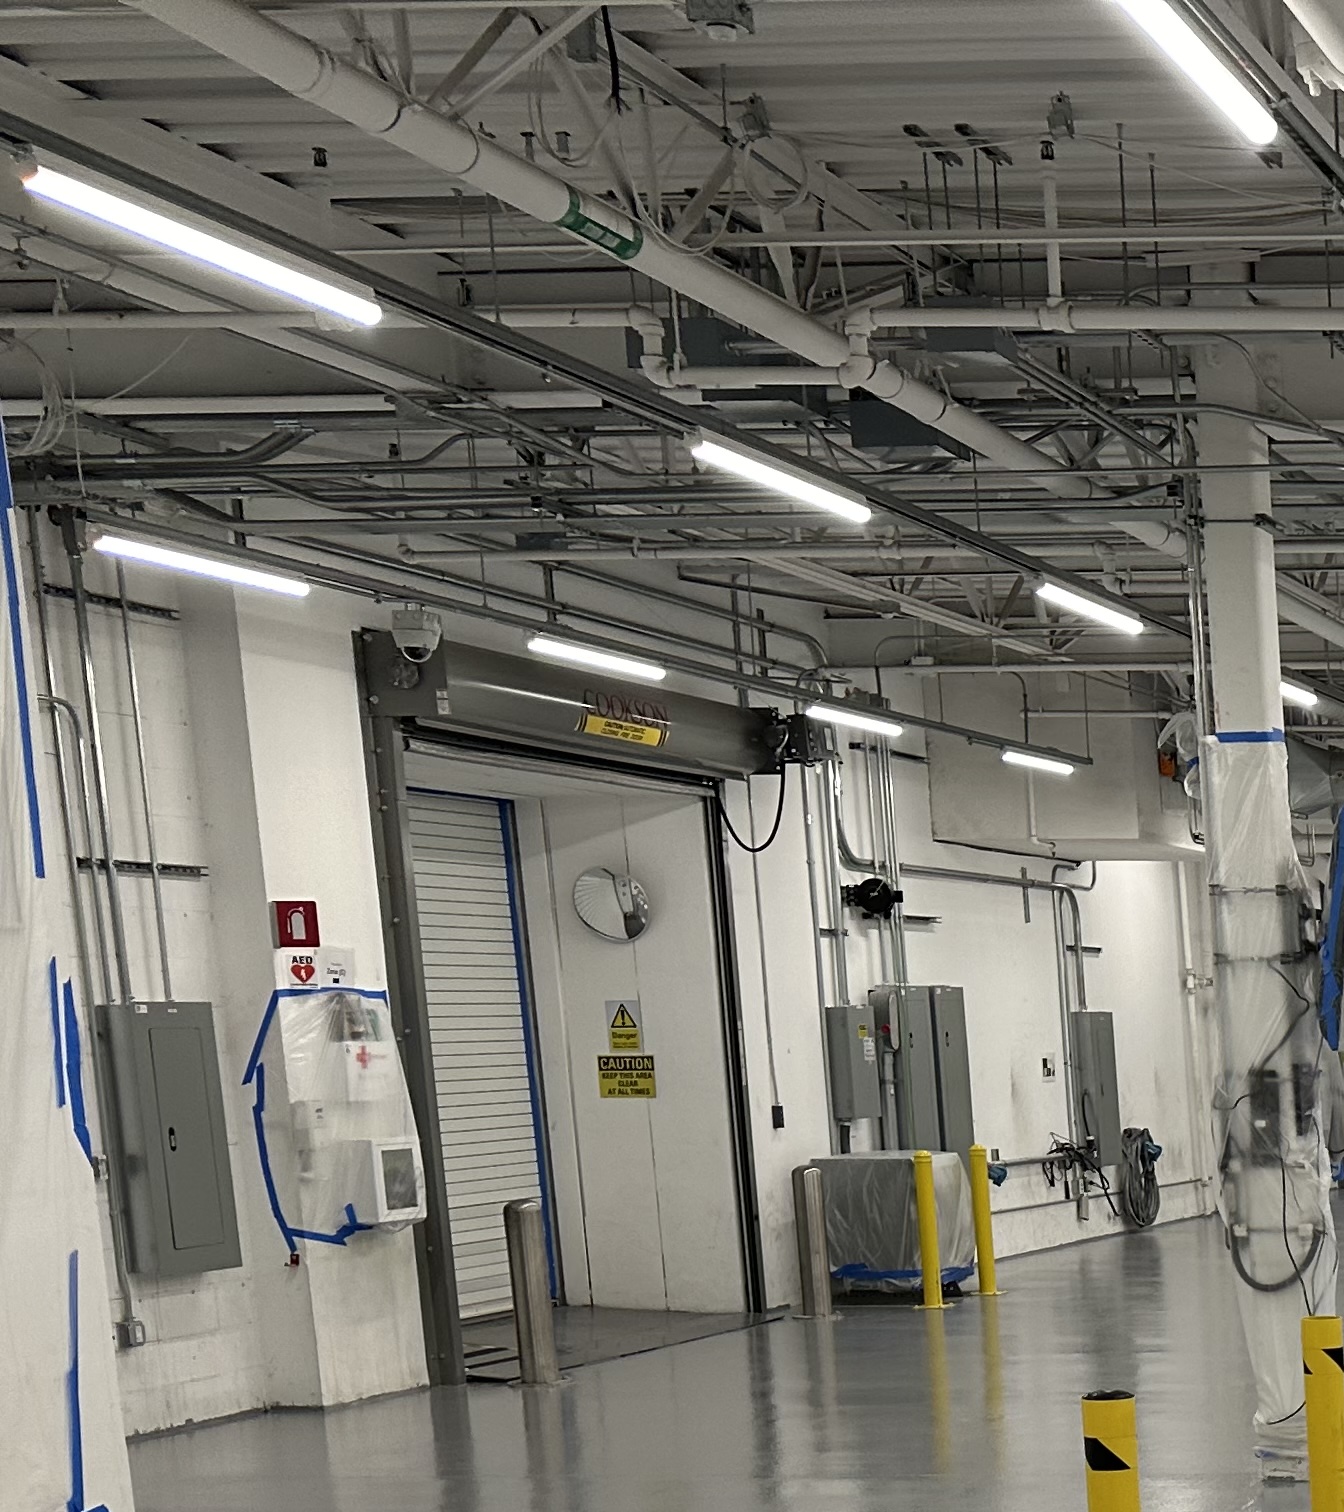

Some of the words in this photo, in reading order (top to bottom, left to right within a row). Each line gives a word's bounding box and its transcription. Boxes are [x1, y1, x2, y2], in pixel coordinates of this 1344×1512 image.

[584, 690, 669, 729] COOKSON
[292, 956, 313, 964] AED
[612, 1032, 637, 1040] Danger
[600, 1058, 652, 1069] CAUTION
